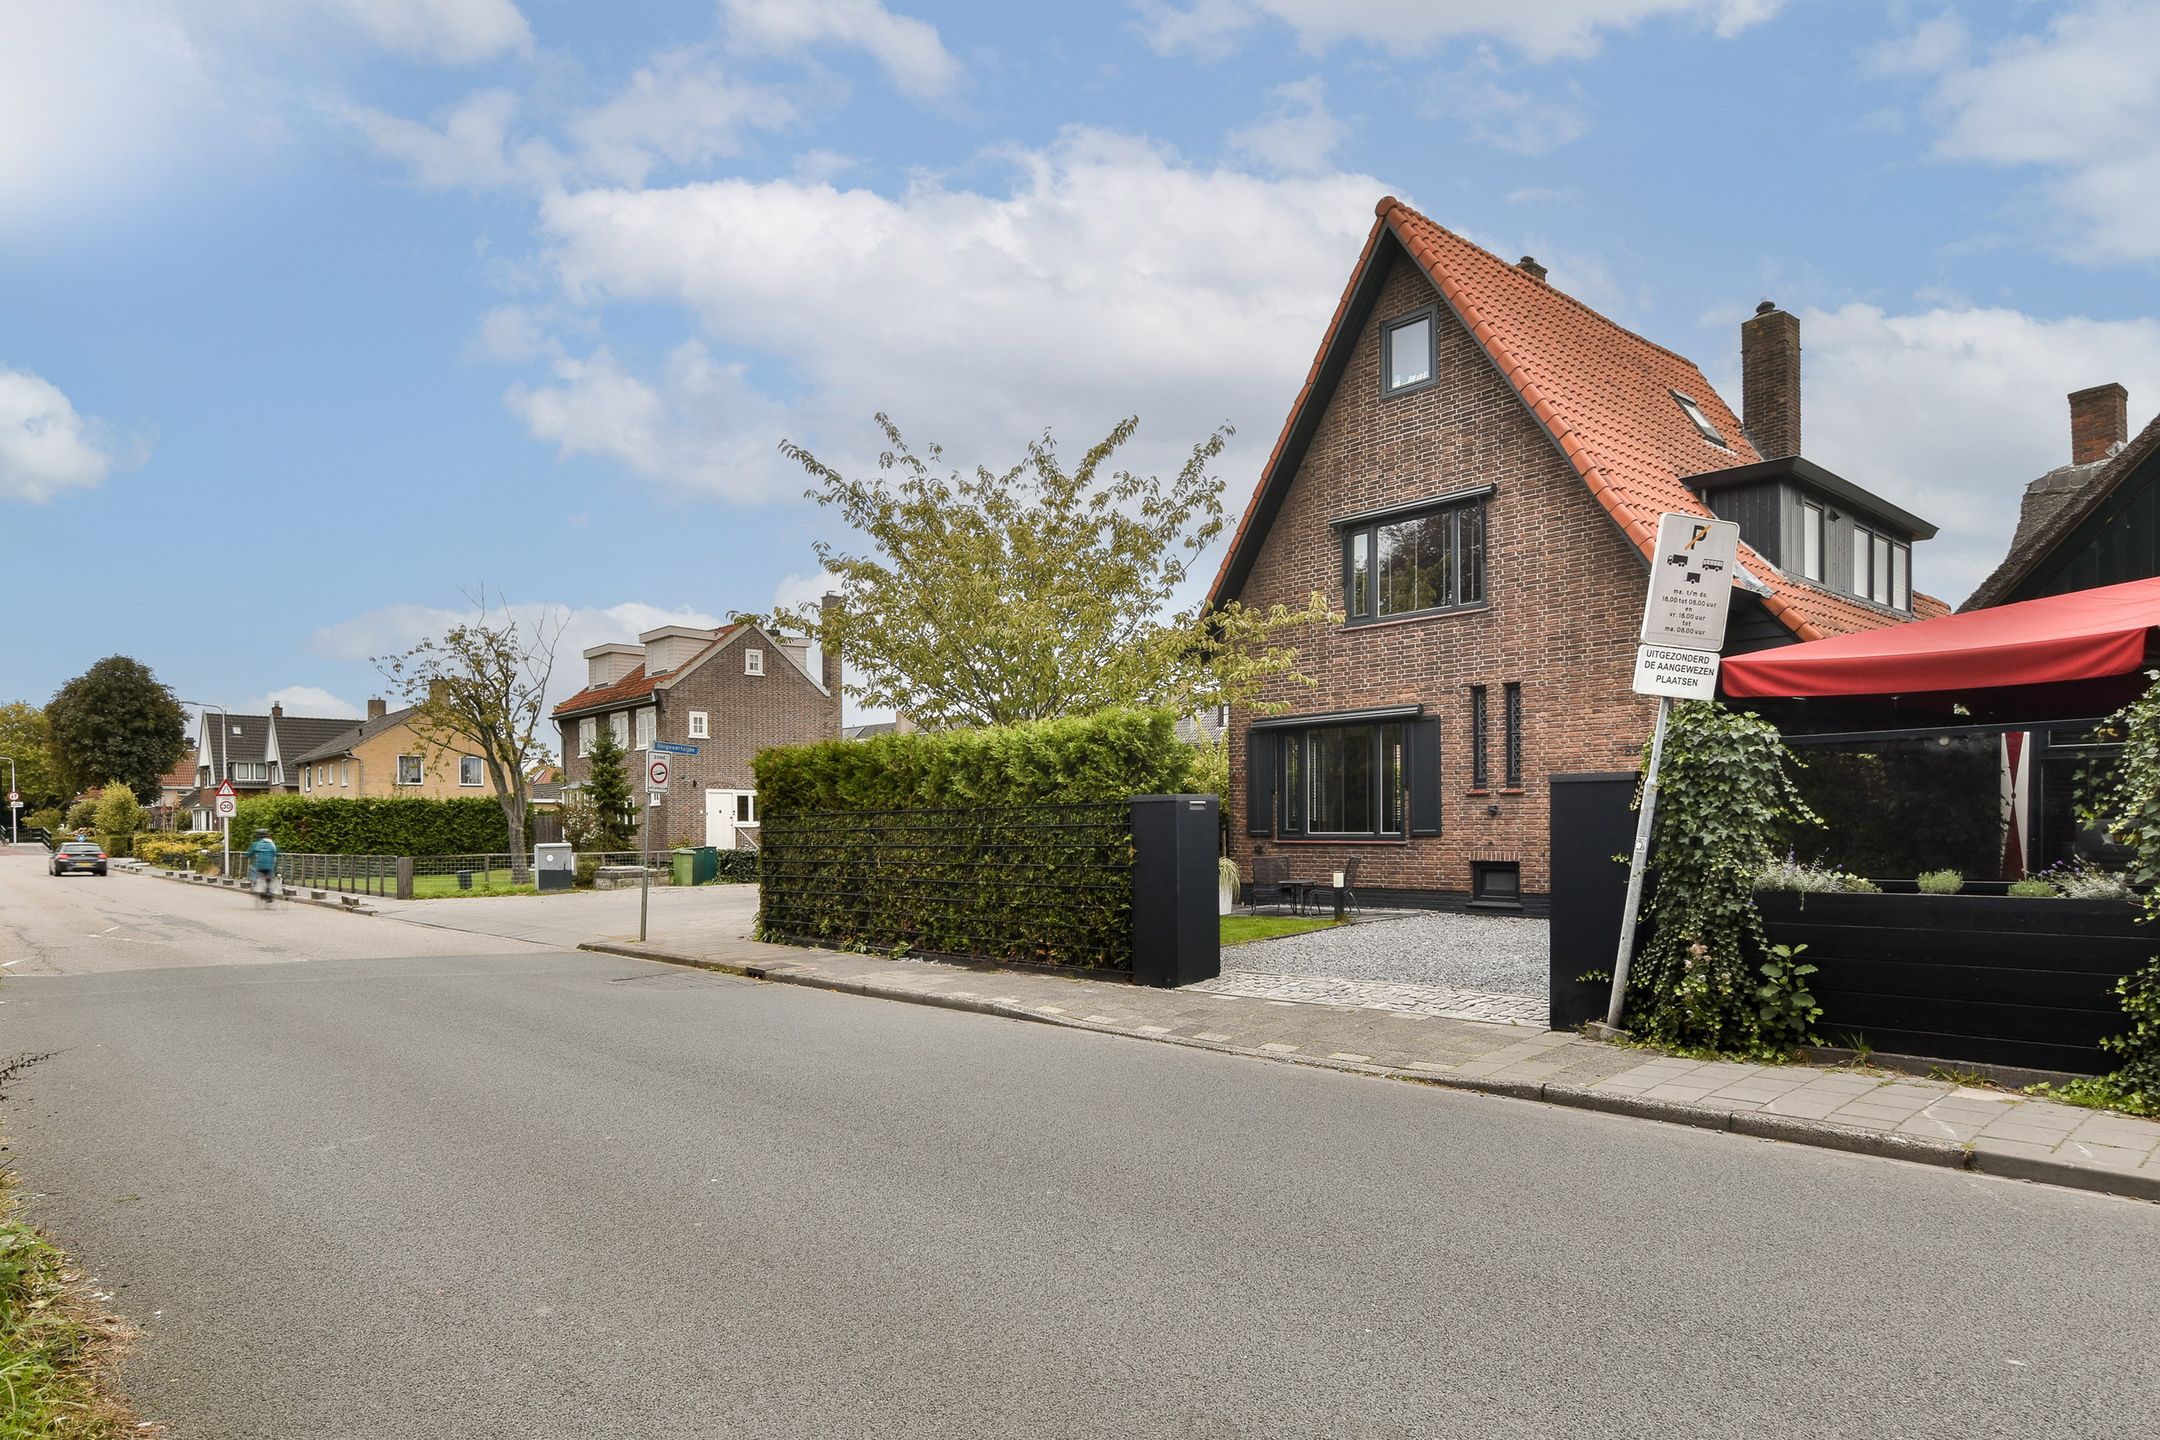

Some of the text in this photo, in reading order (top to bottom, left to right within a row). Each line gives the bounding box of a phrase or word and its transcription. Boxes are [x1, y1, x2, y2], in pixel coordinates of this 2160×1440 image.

[1662, 595, 1678, 603] 18.00
[1689, 599, 1706, 607] 08.00
[1679, 612, 1694, 620] 18.00
[1676, 626, 1694, 634] 08.00
[1646, 649, 1710, 664] UITGEZONDERD
[1644, 661, 1715, 676] DE AANGEWEZEN
[1655, 674, 1699, 687] PLAATSEN
